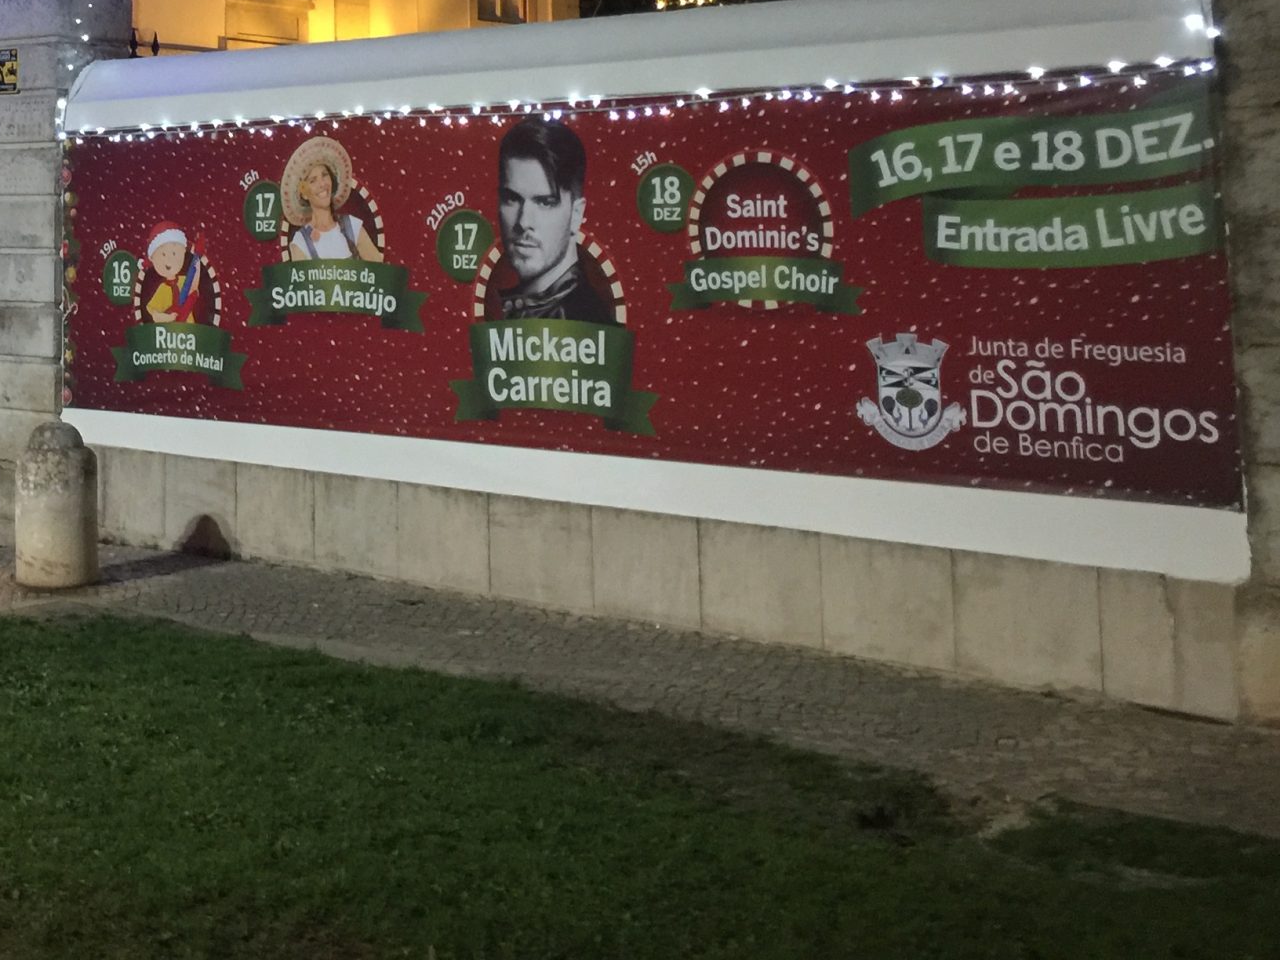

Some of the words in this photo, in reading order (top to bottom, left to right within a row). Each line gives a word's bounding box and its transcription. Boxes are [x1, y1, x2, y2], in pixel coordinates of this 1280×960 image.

[994, 140, 1021, 169] e
[1031, 131, 1086, 172] 18
[1096, 112, 1215, 169] DEZ.
[630, 149, 657, 176] 15h
[239, 169, 259, 191] 16h
[651, 175, 681, 205] 18
[255, 193, 275, 217] 17
[426, 190, 466, 231] 21h30
[653, 207, 682, 222] DEZ
[726, 193, 788, 219] Saint
[255, 220, 276, 232] DEZ
[454, 223, 478, 250] 17
[937, 214, 1088, 253] Entrada
[1096, 204, 1205, 249] Livre
[99, 239, 117, 259] 19h
[453, 254, 478, 270] DEZ
[112, 261, 131, 283] 16
[290, 267, 305, 283] As
[308, 265, 357, 282] músicas
[359, 266, 376, 284] da
[689, 264, 767, 294] Gospel
[773, 265, 839, 295] Choir
[113, 285, 131, 297] DEZ
[272, 287, 326, 310] Sónia
[330, 285, 397, 316] Araújo
[155, 326, 196, 351] Ruca
[489, 327, 606, 366] Mickael
[968, 335, 1029, 358] Junta
[1035, 338, 1064, 359] de
[1072, 339, 1186, 366] Freguesia
[133, 352, 178, 366] Concerto
[179, 352, 193, 366] de
[195, 352, 223, 371] Natal
[487, 367, 611, 408] Carreira
[969, 365, 995, 385] de
[996, 359, 1086, 402] São
[971, 390, 1220, 449] Domingos
[974, 434, 1009, 456] de
[1020, 435, 1124, 463] Benfica
